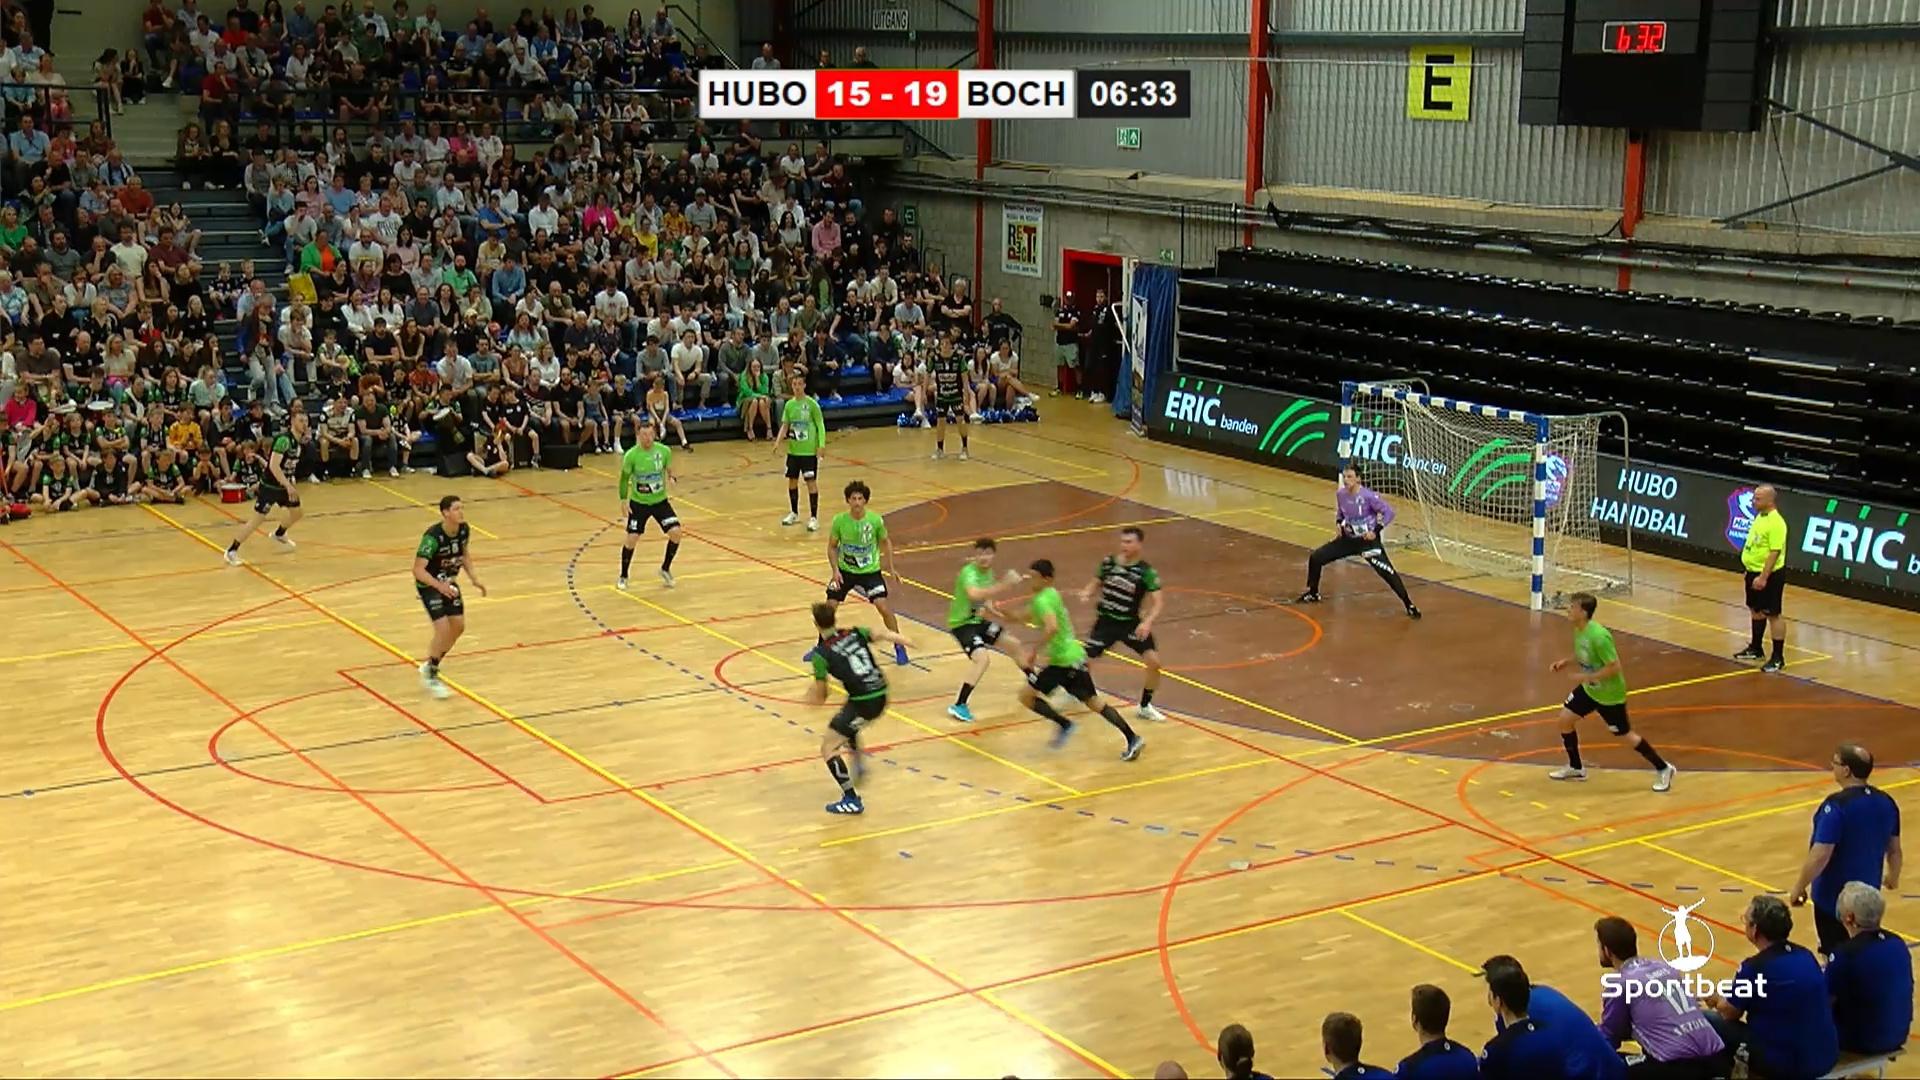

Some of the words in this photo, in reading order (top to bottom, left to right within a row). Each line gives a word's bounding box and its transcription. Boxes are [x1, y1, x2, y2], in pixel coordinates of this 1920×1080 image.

[874, 10, 907, 28] UITGANG
[1424, 54, 1455, 111] E
[1164, 390, 1221, 427] ERIC
[1220, 412, 1259, 436] banden
[1617, 468, 1678, 500] HUBO
[1590, 497, 1689, 539] HANDBAL
[1802, 515, 1905, 570] ERIC
